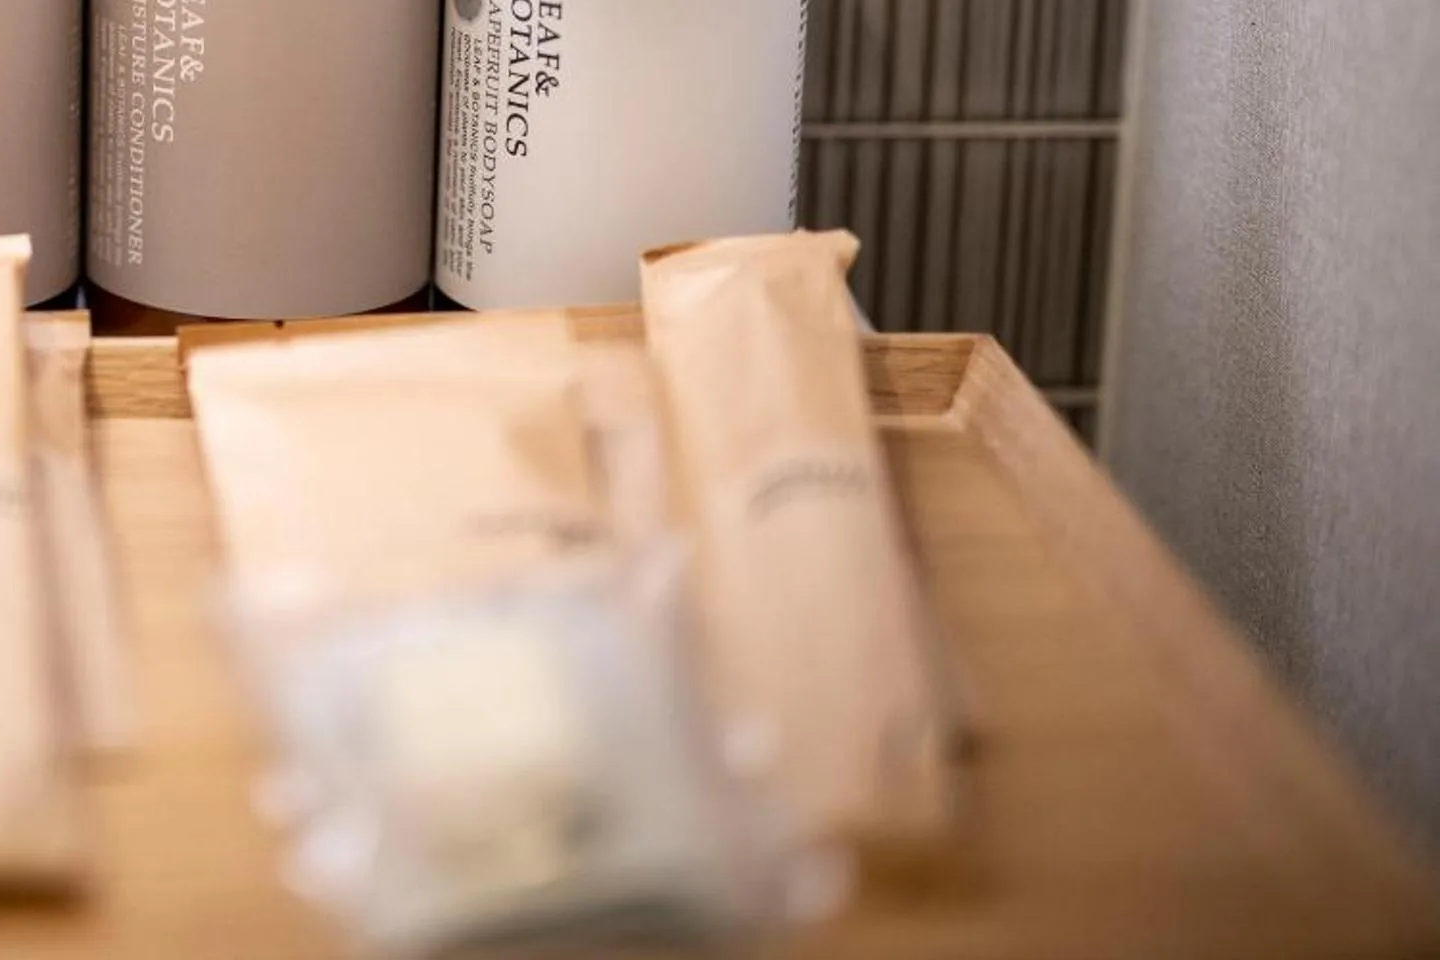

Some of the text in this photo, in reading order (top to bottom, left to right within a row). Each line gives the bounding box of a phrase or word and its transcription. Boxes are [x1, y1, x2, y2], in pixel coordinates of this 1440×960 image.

[128, 90, 146, 265] CONDITIONER
[470, 92, 481, 161] BOTANICS
[480, 121, 498, 254] BODYSOAP
